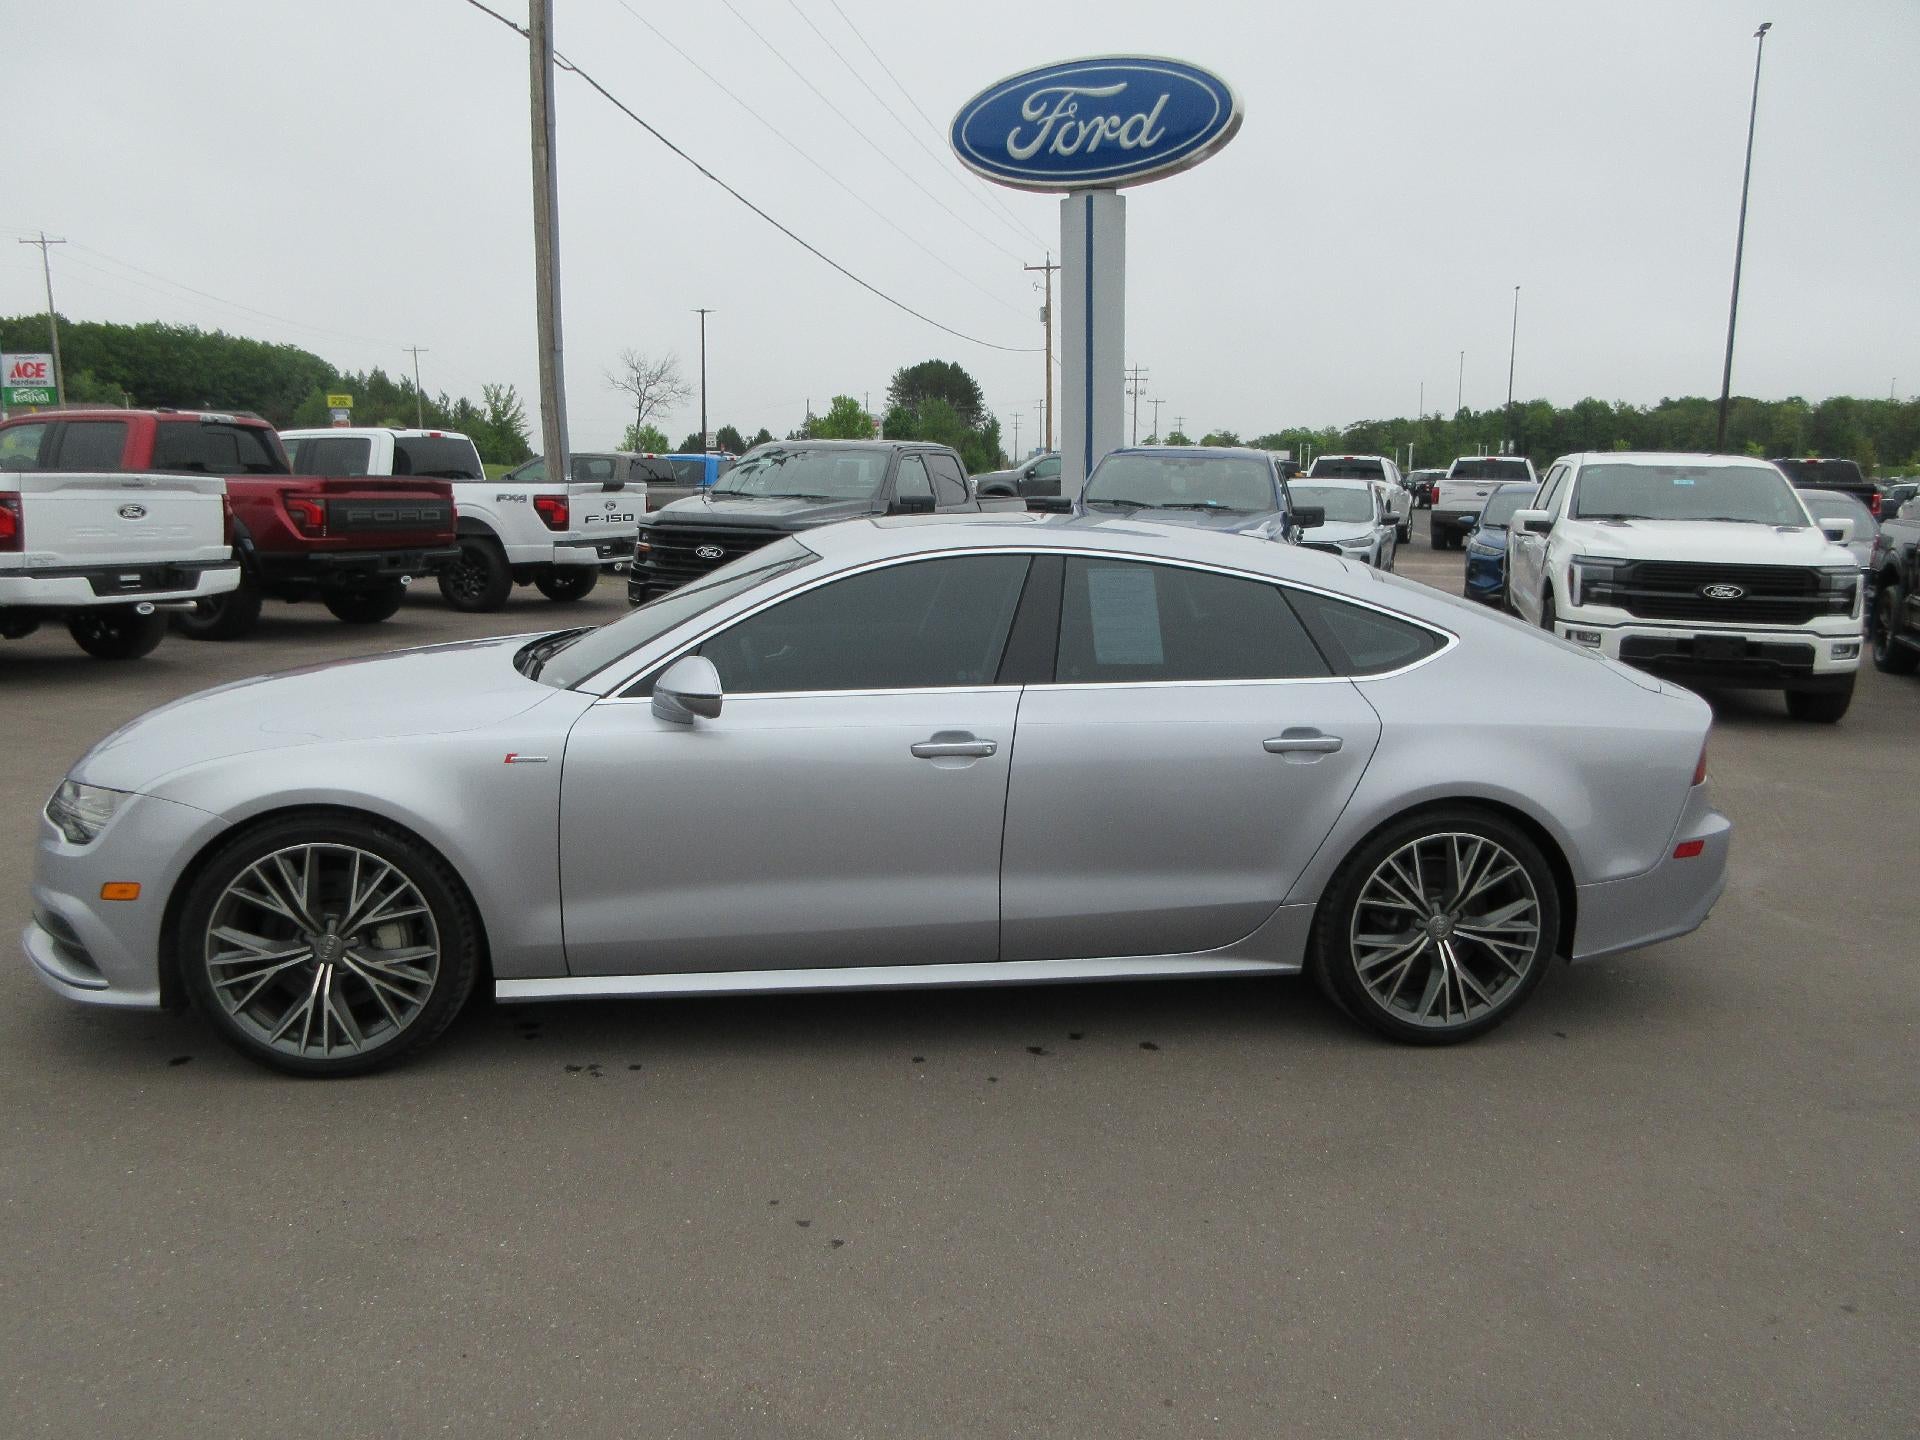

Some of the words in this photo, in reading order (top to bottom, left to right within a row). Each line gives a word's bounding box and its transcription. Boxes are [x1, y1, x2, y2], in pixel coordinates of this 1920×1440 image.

[1007, 82, 1170, 160] Ford
[10, 361, 47, 378] ACE
[496, 494, 527, 503] FX4
[347, 510, 441, 521] FORD
[585, 513, 634, 524] F-150
[1711, 586, 1736, 597] Ford
